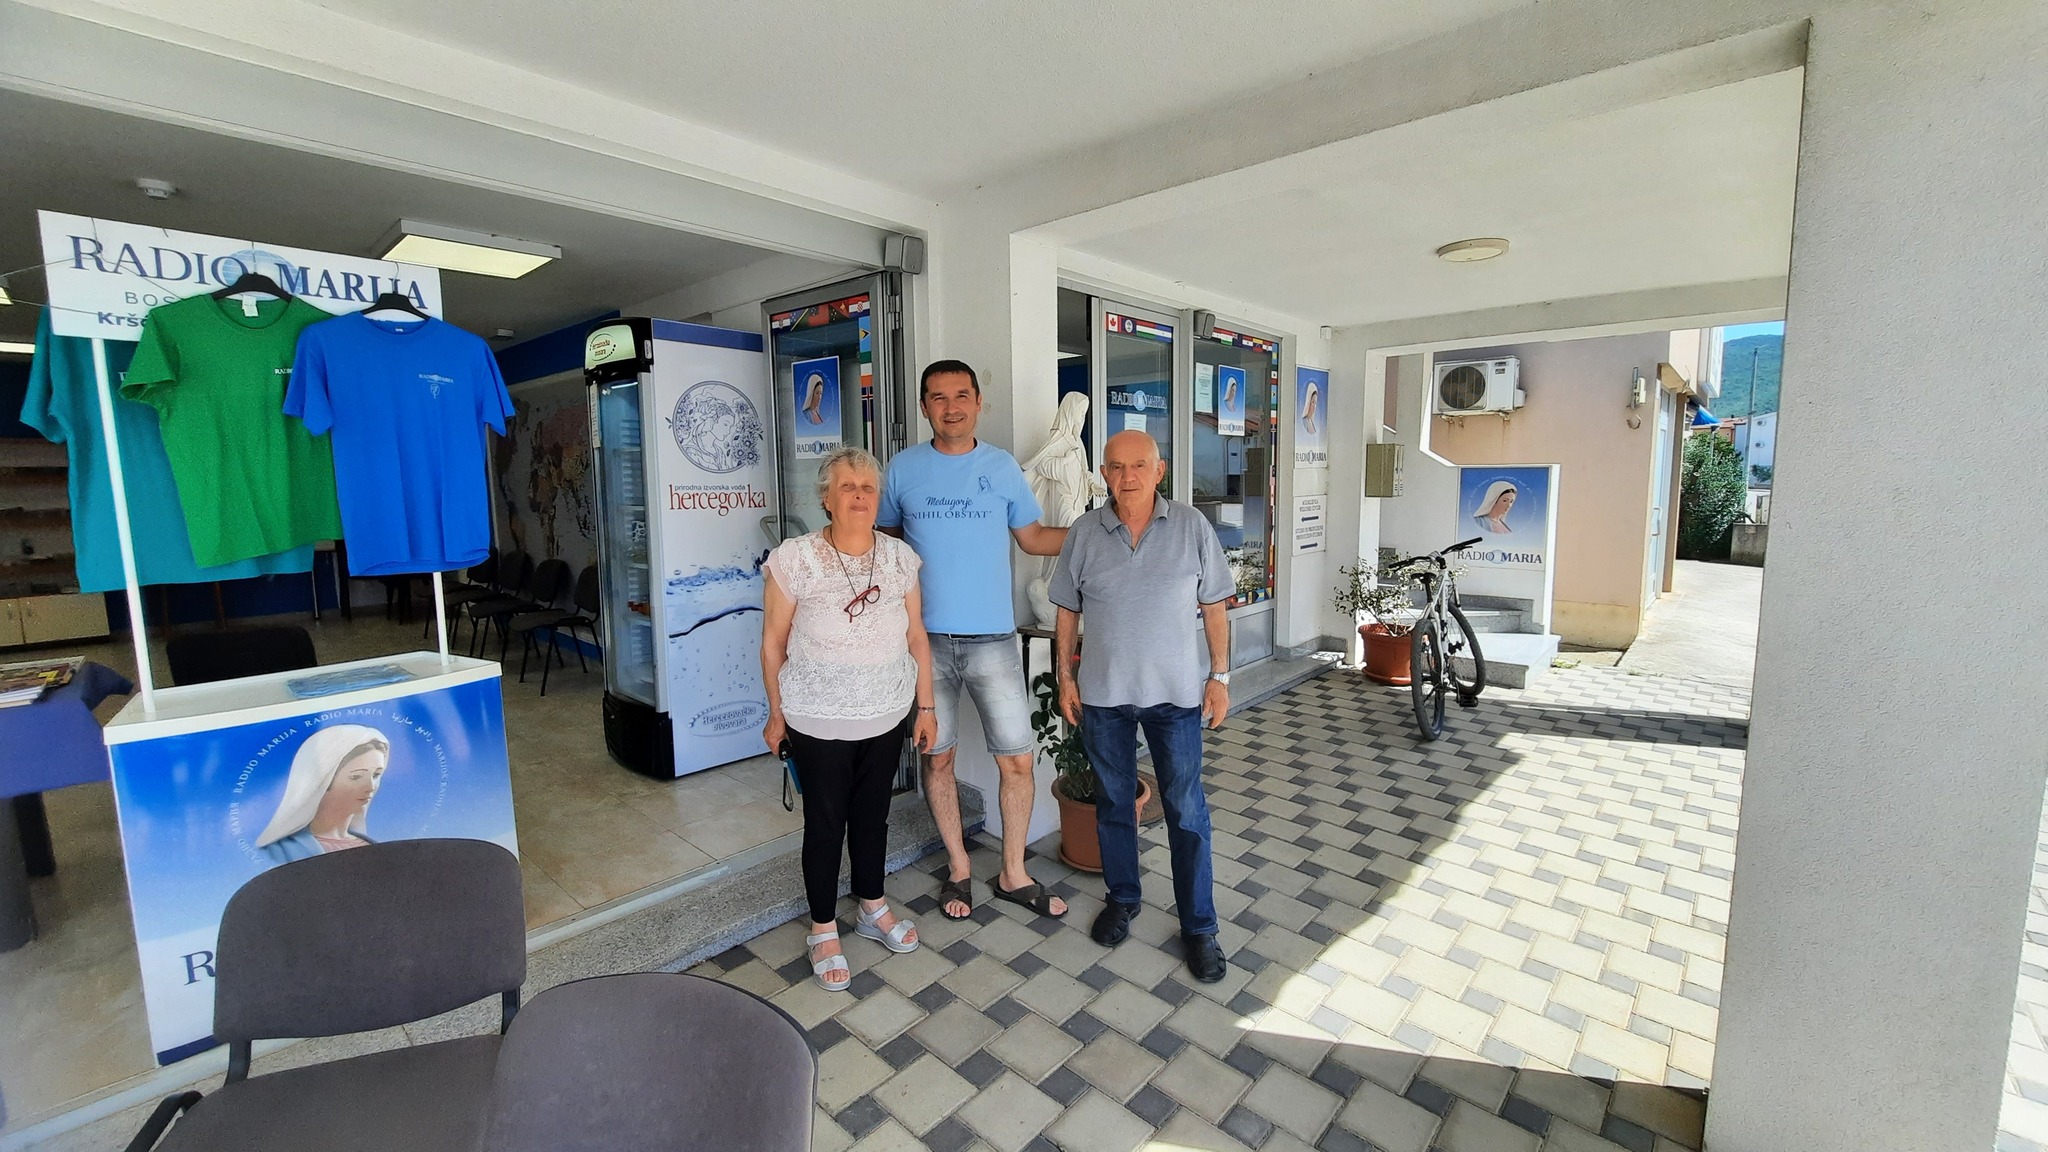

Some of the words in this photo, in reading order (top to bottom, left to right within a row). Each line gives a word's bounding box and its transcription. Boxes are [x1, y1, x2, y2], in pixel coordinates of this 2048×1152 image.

[67, 234, 248, 287] RADIO
[125, 291, 182, 306] BOS
[796, 442, 816, 453] RADIO
[819, 442, 840, 452] MARI
[669, 483, 767, 516] hercegovka
[1457, 550, 1495, 561] RADIO
[1500, 552, 1542, 563] MARIA
[304, 710, 342, 727] RADIO
[347, 707, 383, 716] MARIA
[233, 760, 258, 794] RADIJO
[257, 728, 298, 758] MARIJA
